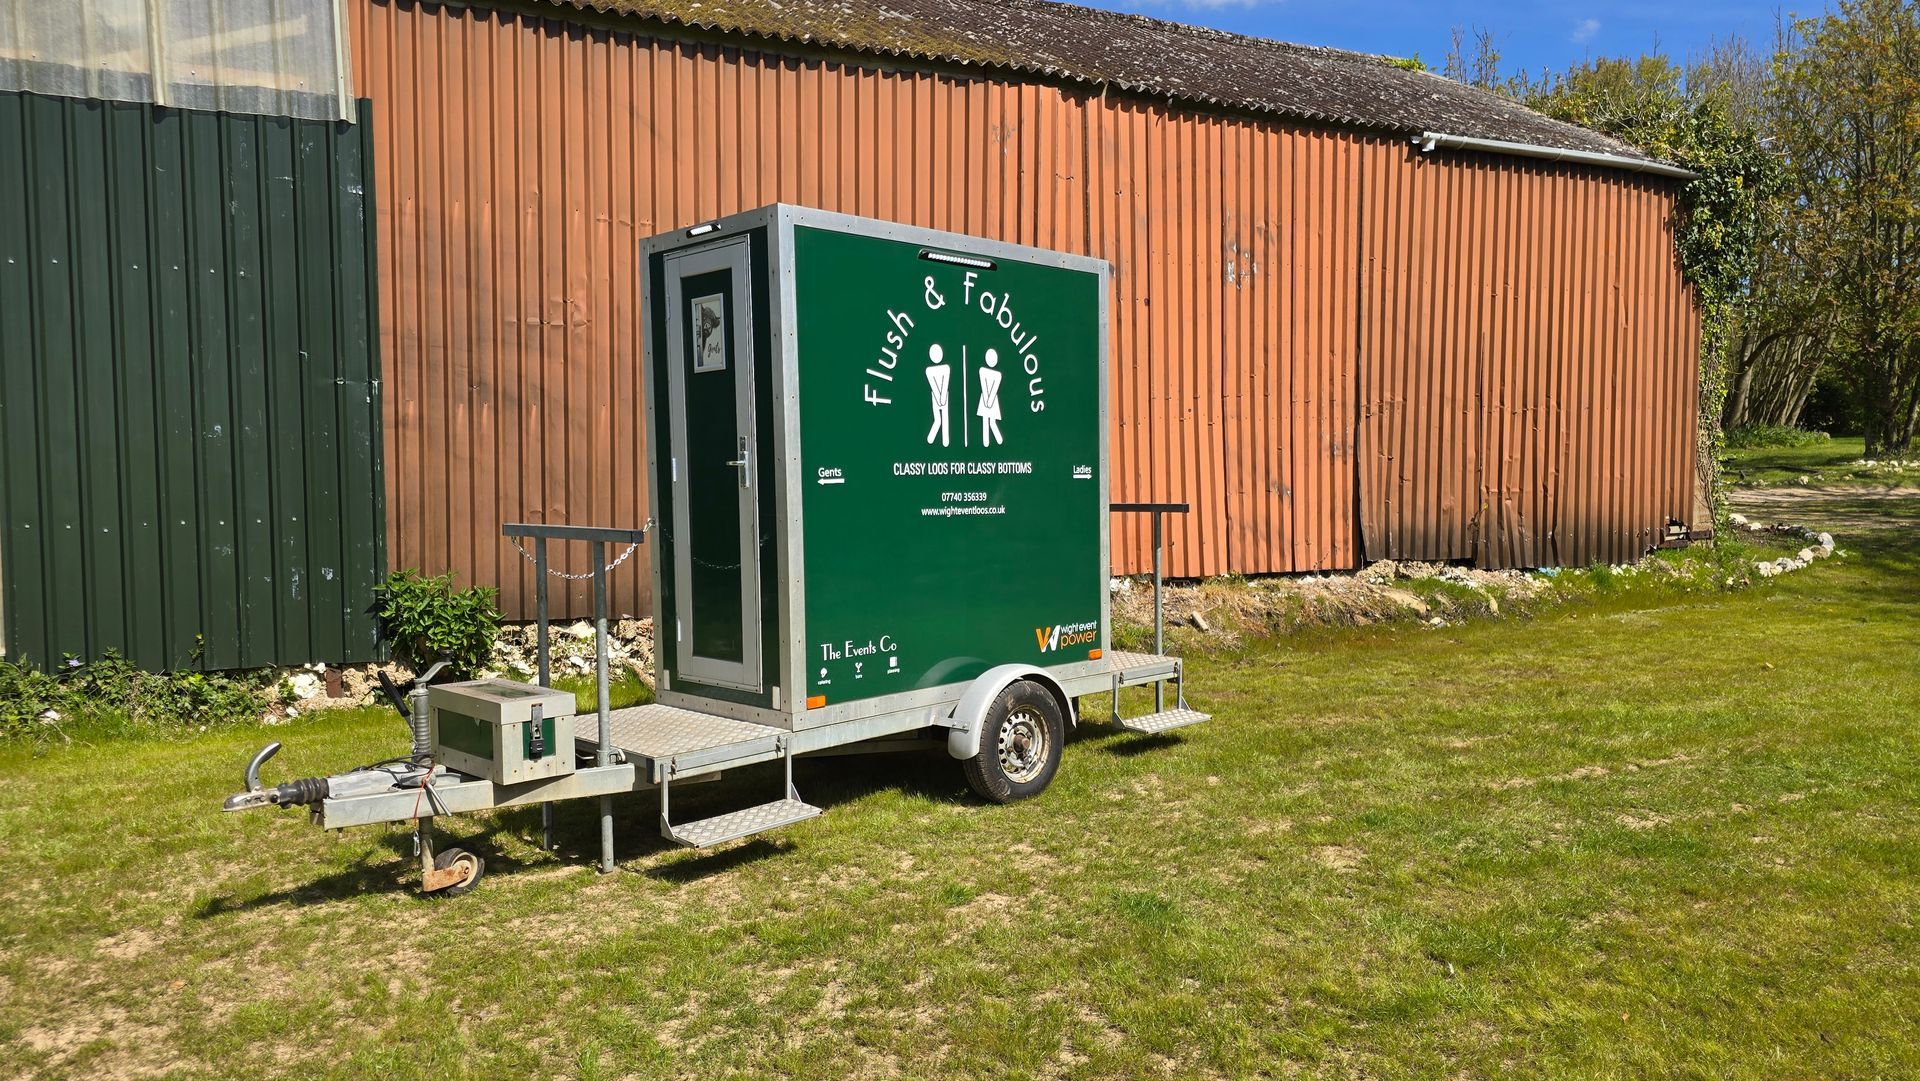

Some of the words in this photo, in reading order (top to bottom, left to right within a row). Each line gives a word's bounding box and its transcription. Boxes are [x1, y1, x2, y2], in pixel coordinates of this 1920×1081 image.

[864, 309, 915, 406] Flush
[924, 275, 946, 310] &
[963, 271, 1045, 413] Fabulous
[817, 467, 842, 478] Gents
[893, 462, 926, 476] CLASSY
[927, 462, 949, 476] LOOS
[950, 462, 966, 475] FOR
[967, 462, 997, 475] CLASSY
[997, 461, 1033, 475] BOTTOMS
[1073, 464, 1092, 474] Ladies
[941, 492, 963, 502] 07740
[963, 491, 988, 502] 356339
[921, 505, 1006, 518] www.wighteventloos.co.uk
[1060, 630, 1098, 650] power
[820, 643, 842, 661] The
[845, 640, 877, 658] Events
[879, 635, 898, 652] Co
